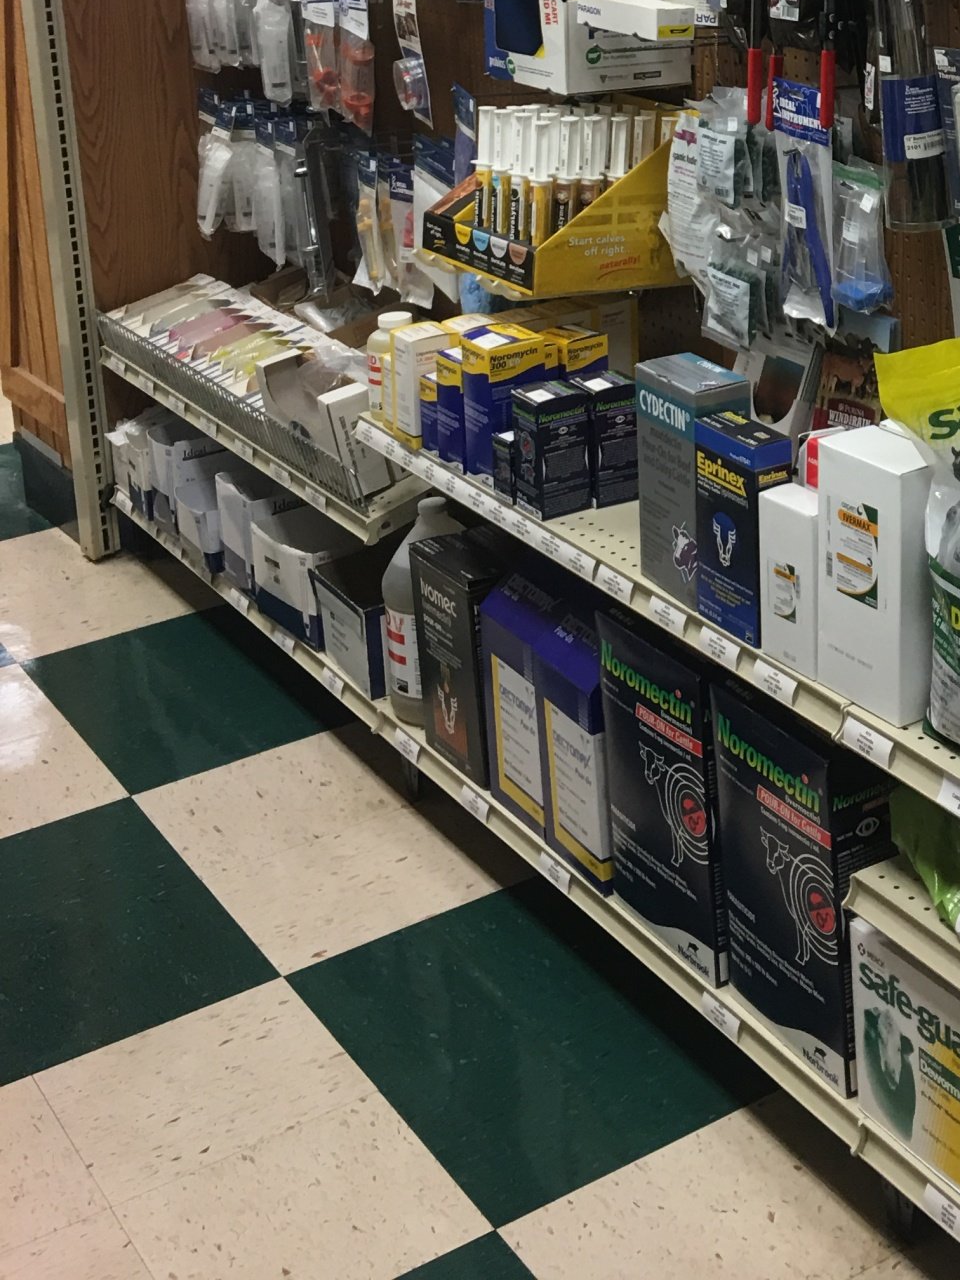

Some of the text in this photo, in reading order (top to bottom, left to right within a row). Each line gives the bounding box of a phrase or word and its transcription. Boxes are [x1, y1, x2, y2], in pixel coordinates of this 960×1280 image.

[568, 234, 625, 246] Start calves
[584, 246, 598, 256] off
[490, 348, 538, 363] Noromycin
[568, 342, 604, 355] Noromycin
[490, 360, 507, 370] 300
[539, 404, 585, 423] Noromectin
[639, 388, 686, 433] CYDECTIN
[697, 450, 747, 489] Eprinex
[758, 470, 788, 483] Eprinex
[420, 577, 457, 618] Ivomec
[601, 639, 693, 725] Noromectin
[639, 704, 693, 751] POUR-ON Cattle
[718, 712, 821, 812] Noromectin
[760, 788, 822, 841] POUR-ON Cattle
